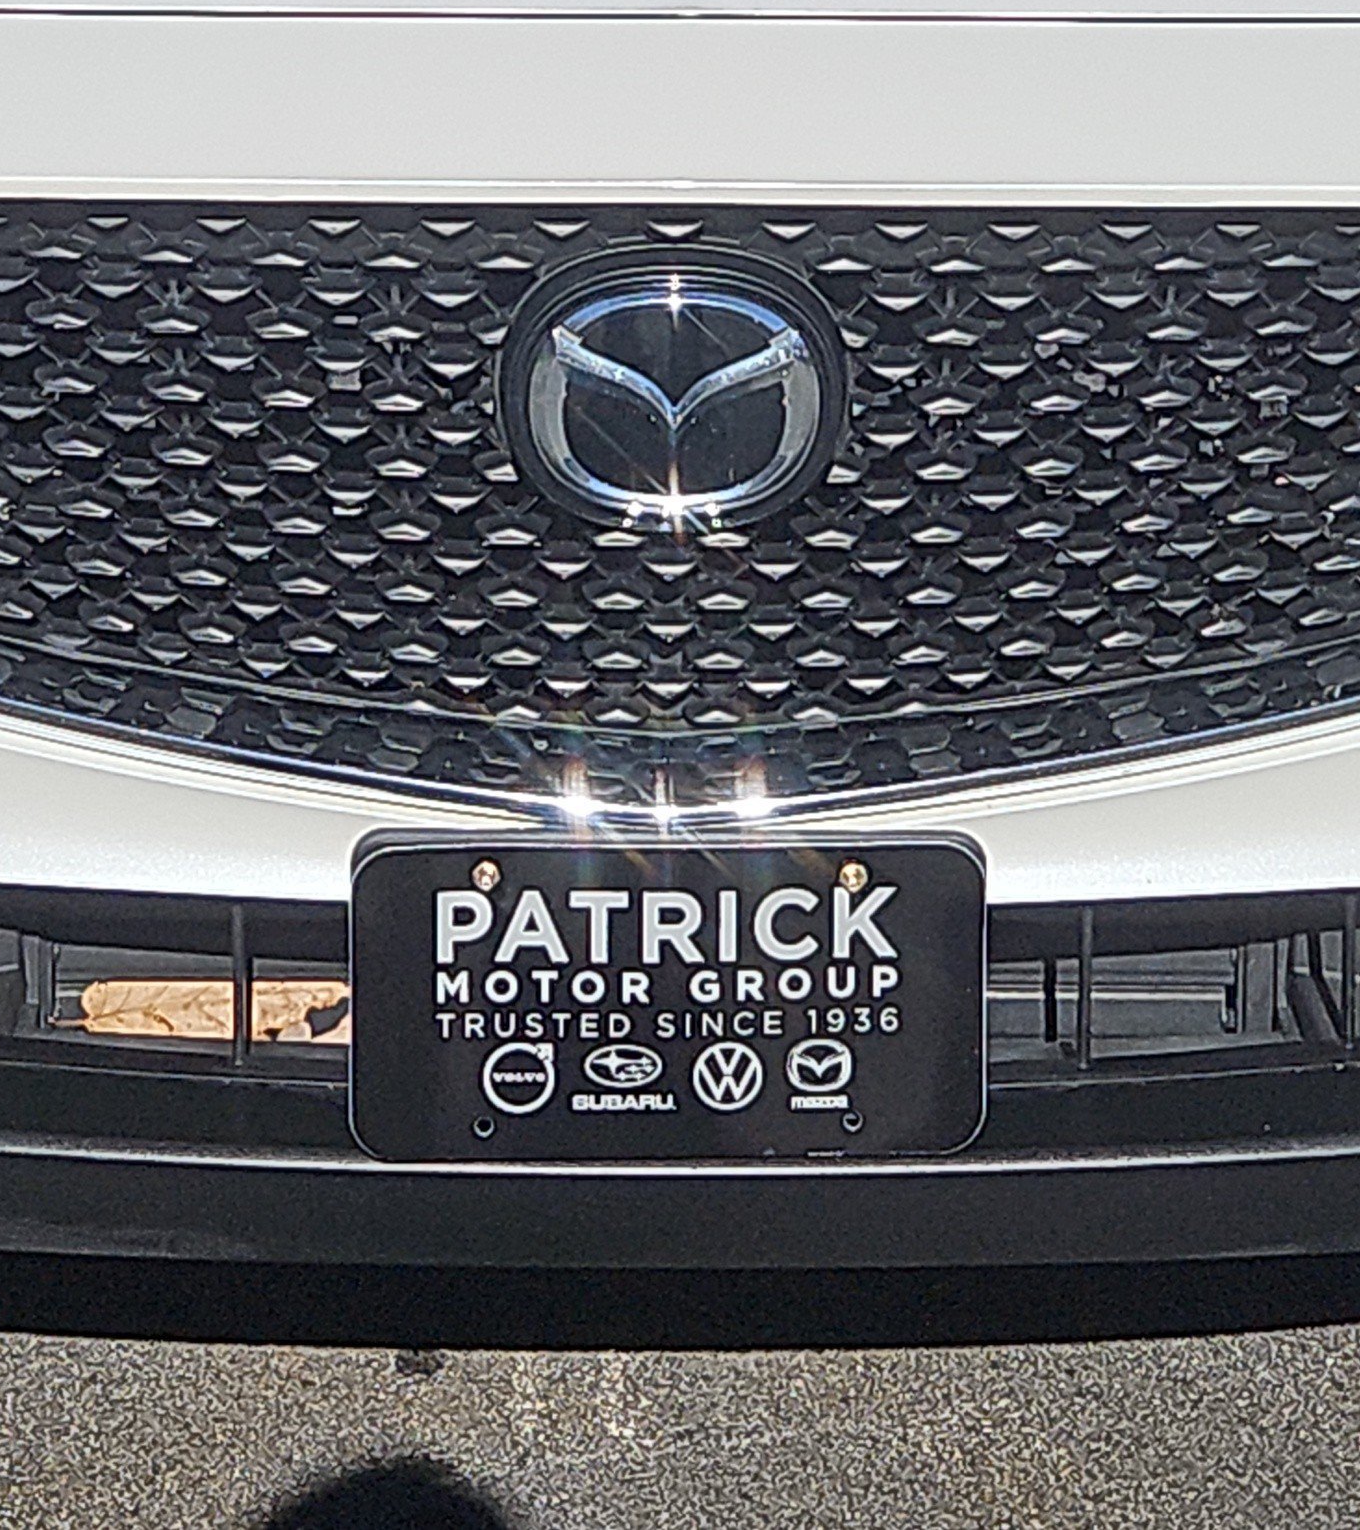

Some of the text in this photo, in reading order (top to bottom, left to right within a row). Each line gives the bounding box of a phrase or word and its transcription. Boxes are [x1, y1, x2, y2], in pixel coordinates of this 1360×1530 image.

[436, 886, 899, 964] PATRICK
[436, 964, 899, 1004] MOTOR GROUP
[435, 1006, 900, 1039] TRUSTED SINCE 1936
[492, 1072, 546, 1083] VOLVO
[572, 1094, 674, 1111] SUBARU
